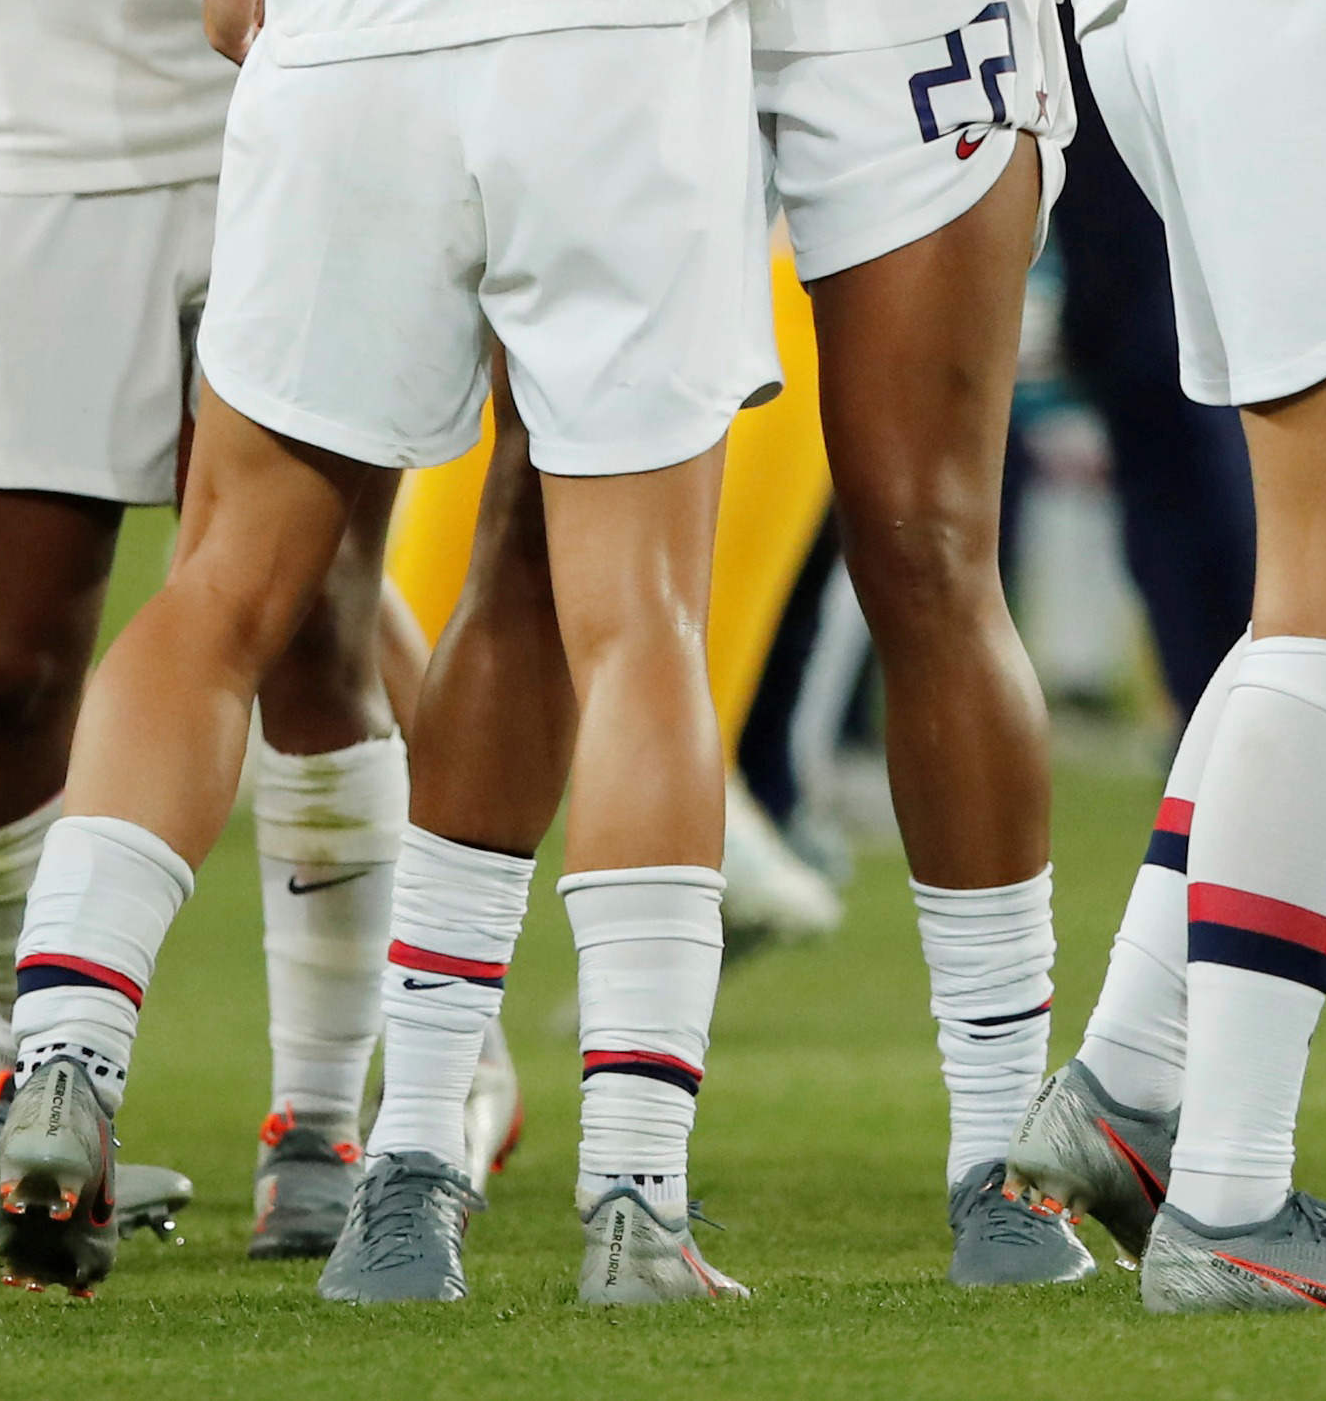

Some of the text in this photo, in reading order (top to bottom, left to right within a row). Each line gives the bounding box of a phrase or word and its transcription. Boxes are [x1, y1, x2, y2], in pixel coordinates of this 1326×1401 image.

[46, 1069, 68, 1138] MERCURIAL
[1018, 1075, 1057, 1145] MERCURIAL
[604, 1210, 626, 1288] MERCURIAL
